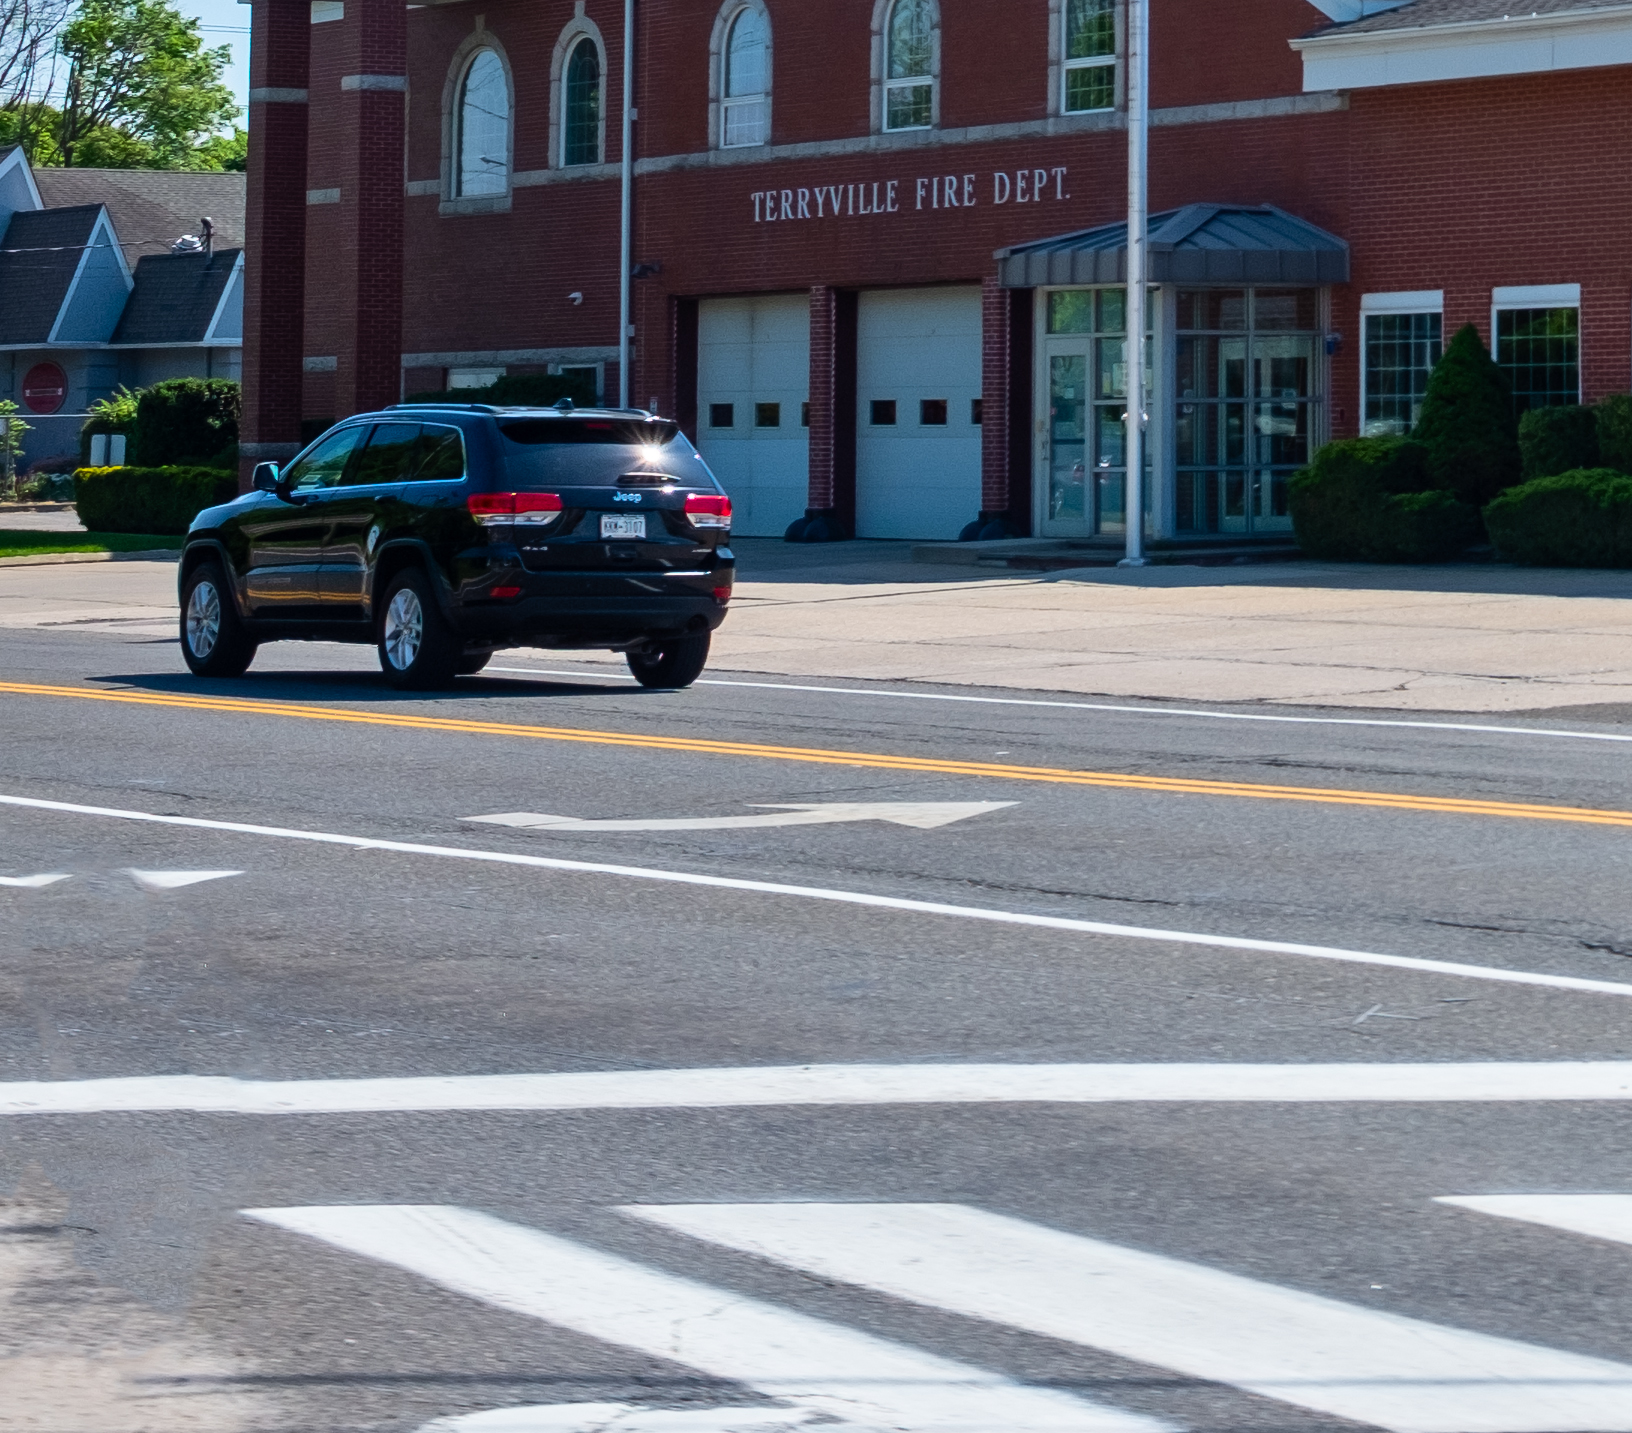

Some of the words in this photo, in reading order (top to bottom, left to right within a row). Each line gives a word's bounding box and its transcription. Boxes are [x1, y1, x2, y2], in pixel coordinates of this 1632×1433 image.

[750, 180, 900, 223] TERRYVILLE
[915, 173, 977, 210] FIRE
[993, 167, 1071, 205] DEPT.
[612, 491, 642, 504] Jeep
